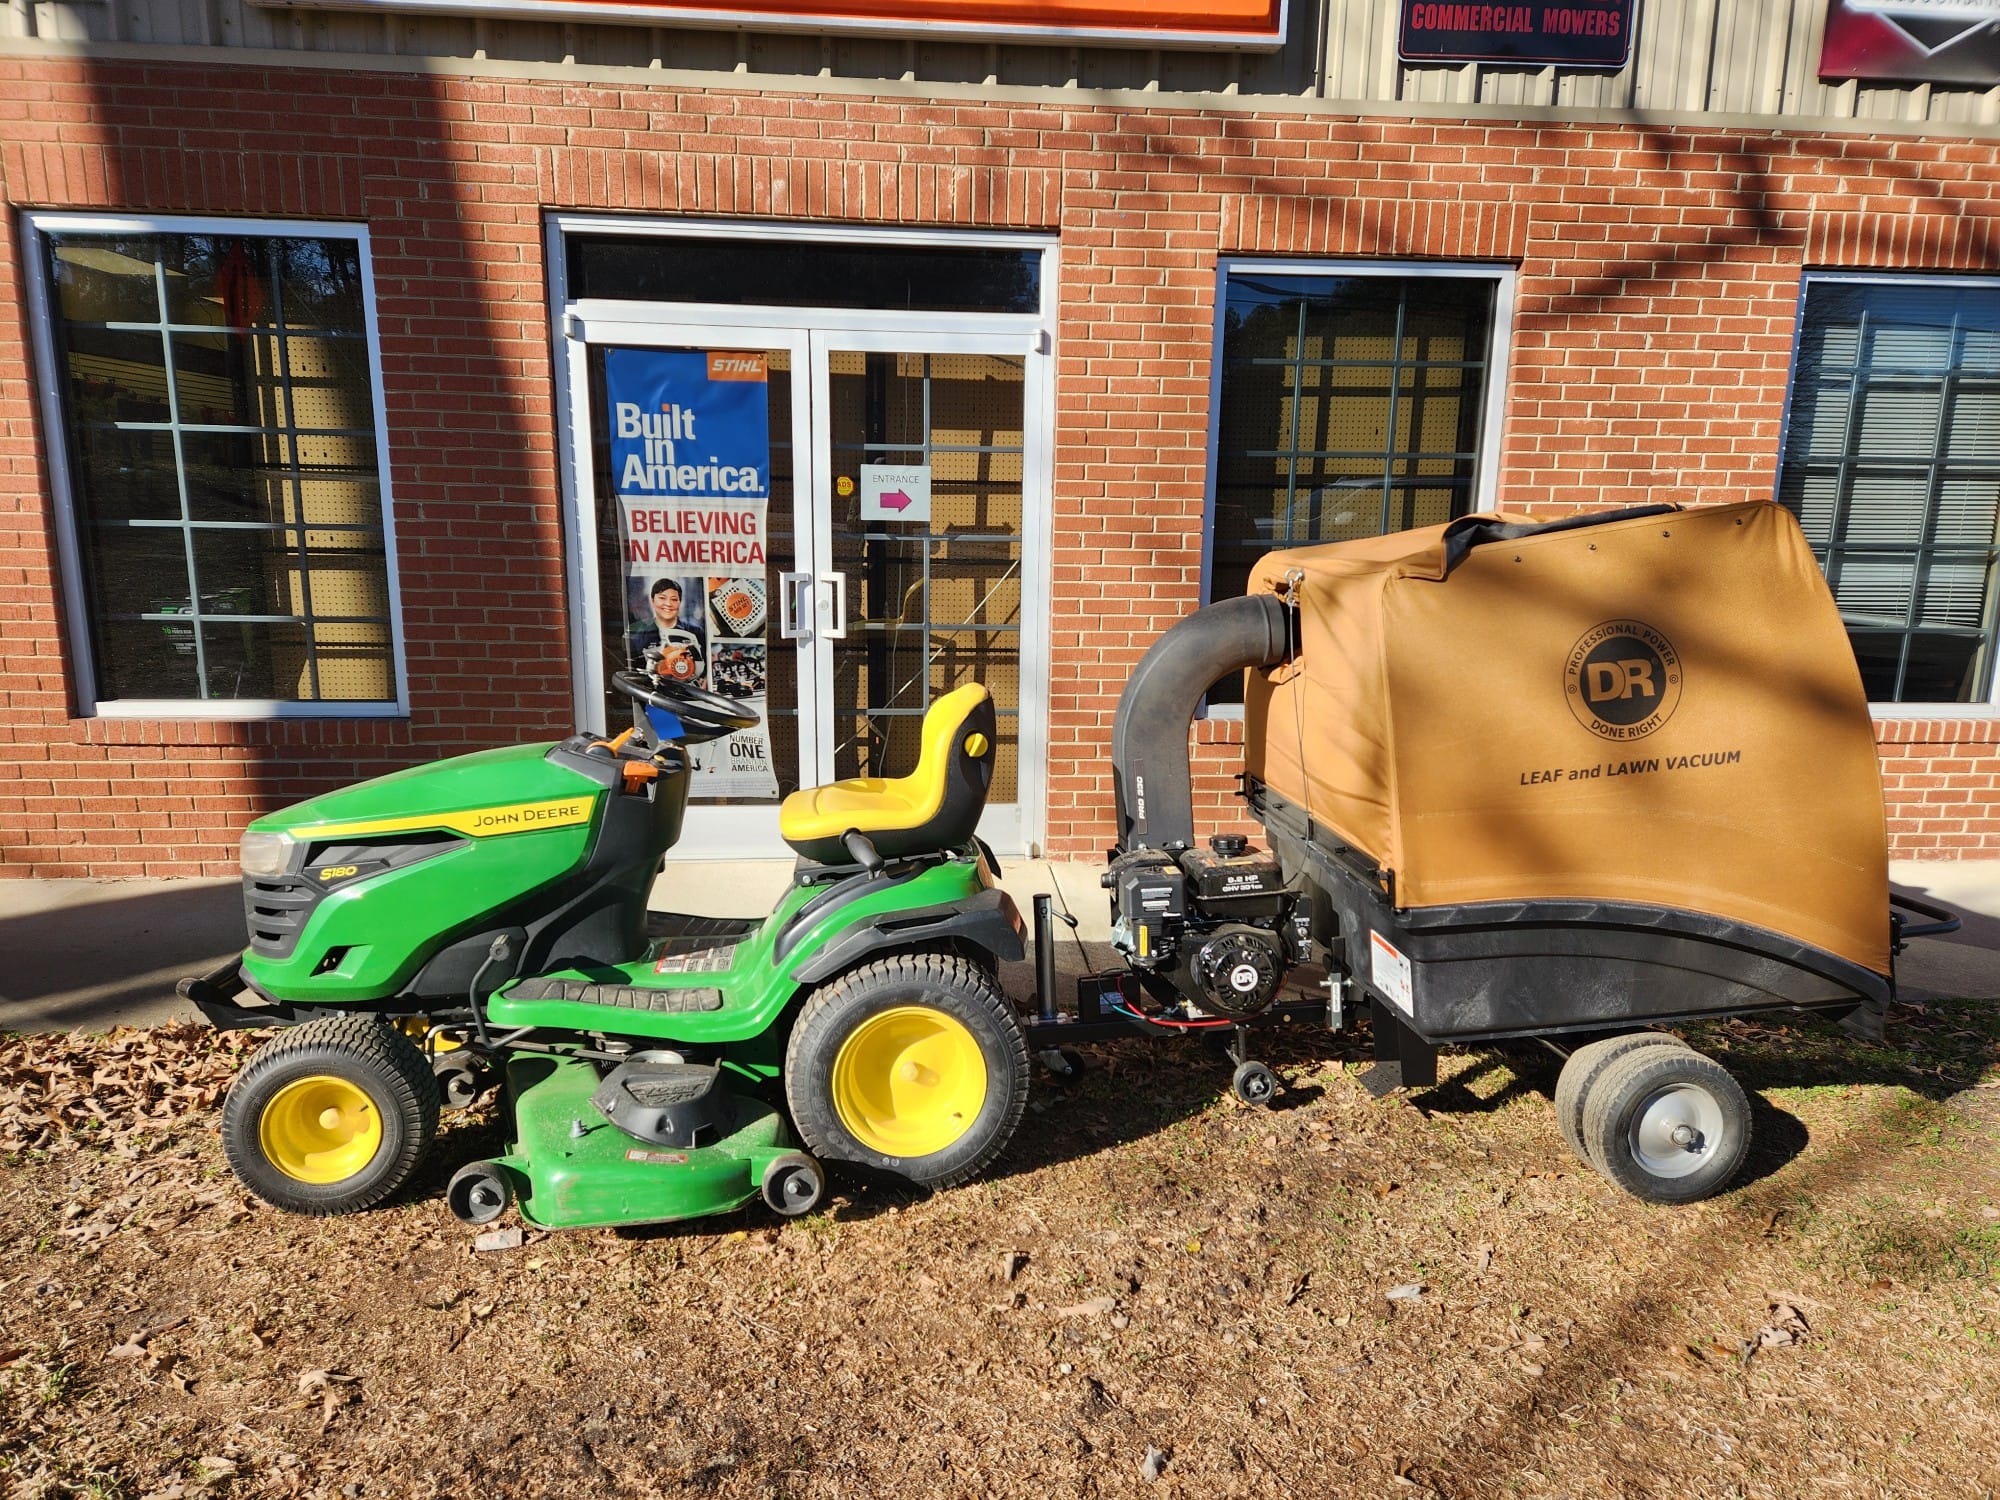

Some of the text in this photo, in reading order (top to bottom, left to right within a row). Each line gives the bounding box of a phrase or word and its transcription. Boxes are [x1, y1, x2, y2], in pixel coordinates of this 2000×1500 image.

[1411, 3, 1621, 36] COMMERCIAL MOWERS
[712, 359, 761, 372] STIHL
[616, 402, 696, 440] Built
[645, 438, 675, 465] in
[621, 454, 765, 492] America.
[872, 474, 920, 484] ENTRANCE
[631, 510, 757, 535] BELIEVING
[624, 539, 766, 564] IN AMERICA
[1568, 624, 1675, 675] PROFESSIONAL POWER
[1586, 658, 1655, 703] DR
[1590, 712, 1664, 738] DONE RIGHT
[729, 734, 763, 745] NUMBER
[729, 742, 766, 759] ONE
[731, 764, 769, 772] AMERICA
[1520, 750, 1742, 786] LEAF and LAWN VACUUM
[473, 805, 580, 828] JOHN DEERE
[1137, 798, 1146, 820] PRO
[319, 865, 358, 881] S180
